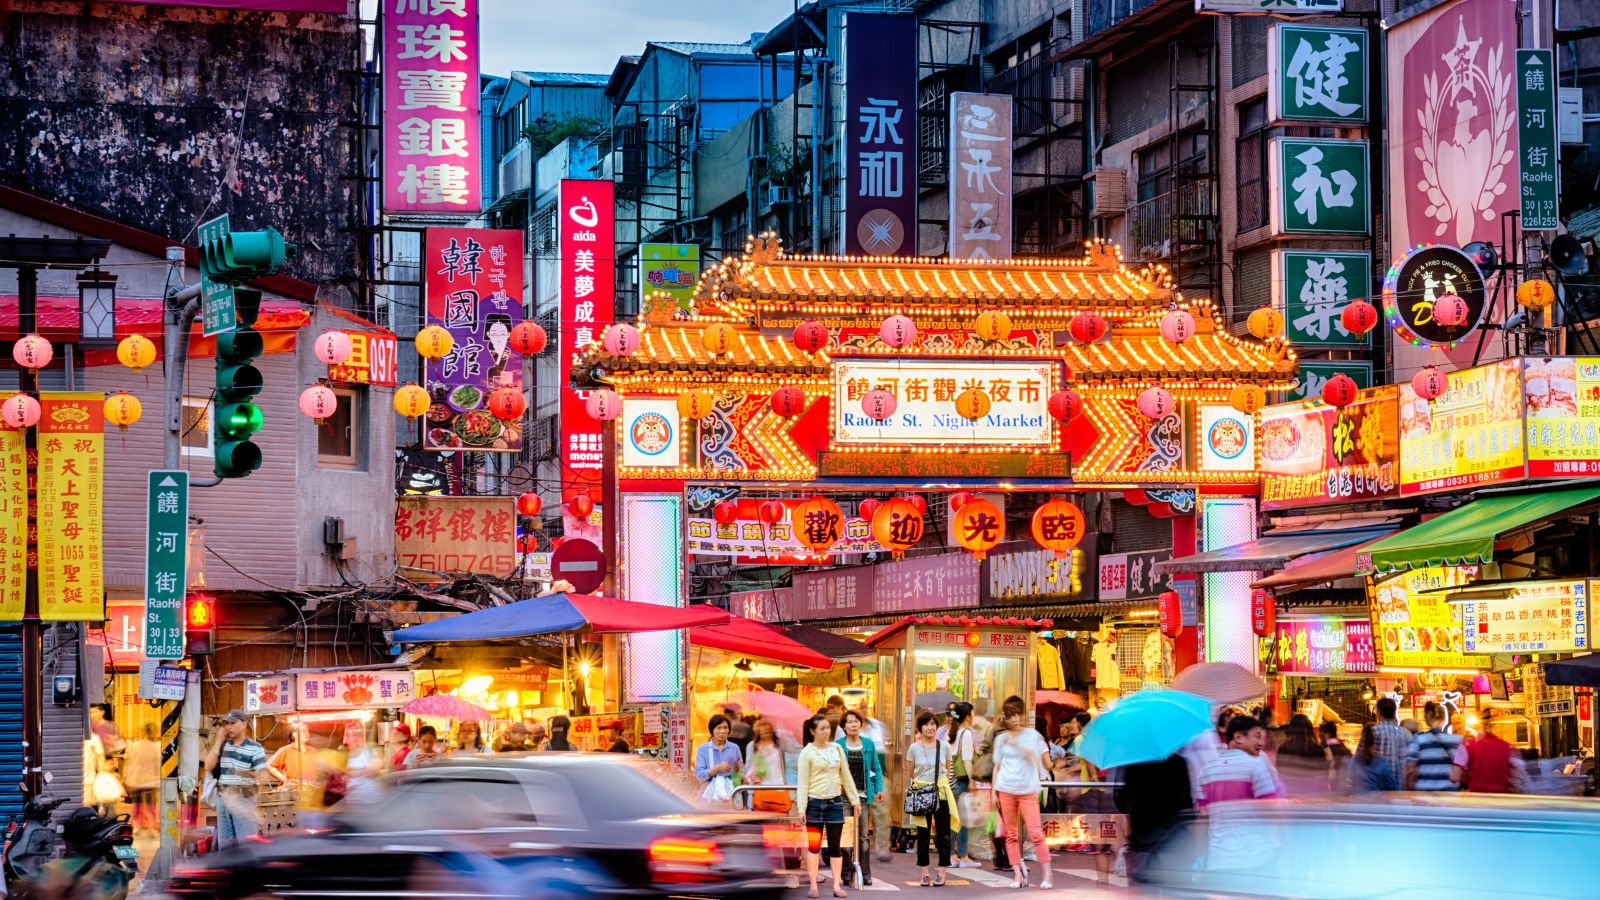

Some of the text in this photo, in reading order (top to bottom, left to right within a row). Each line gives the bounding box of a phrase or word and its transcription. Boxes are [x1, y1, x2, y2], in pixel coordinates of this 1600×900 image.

[1524, 70, 1548, 167] 饒河街
[858, 97, 904, 198] 永和
[1522, 172, 1553, 182] RaoHe
[1522, 187, 1536, 196] St.
[1525, 201, 1554, 210] 30 33
[1523, 217, 1557, 226] 226 255
[573, 230, 597, 242] aida
[438, 238, 485, 380] 韓國館
[902, 413, 922, 427] St.
[987, 414, 1044, 428] Market
[45, 437, 96, 454] 恭祝
[1453, 440, 1465, 458] VS
[804, 510, 840, 544] 歡
[889, 512, 920, 542] 迎
[964, 514, 999, 541] 光
[1041, 514, 1075, 541] 臨
[155, 491, 179, 594] 饒河街
[149, 598, 181, 608] RaoHe
[148, 613, 162, 623] St.
[1574, 584, 1585, 648] 實在老口味
[150, 628, 180, 637] 30 33
[991, 633, 1028, 647] 服務台
[147, 645, 182, 655] 226 255
